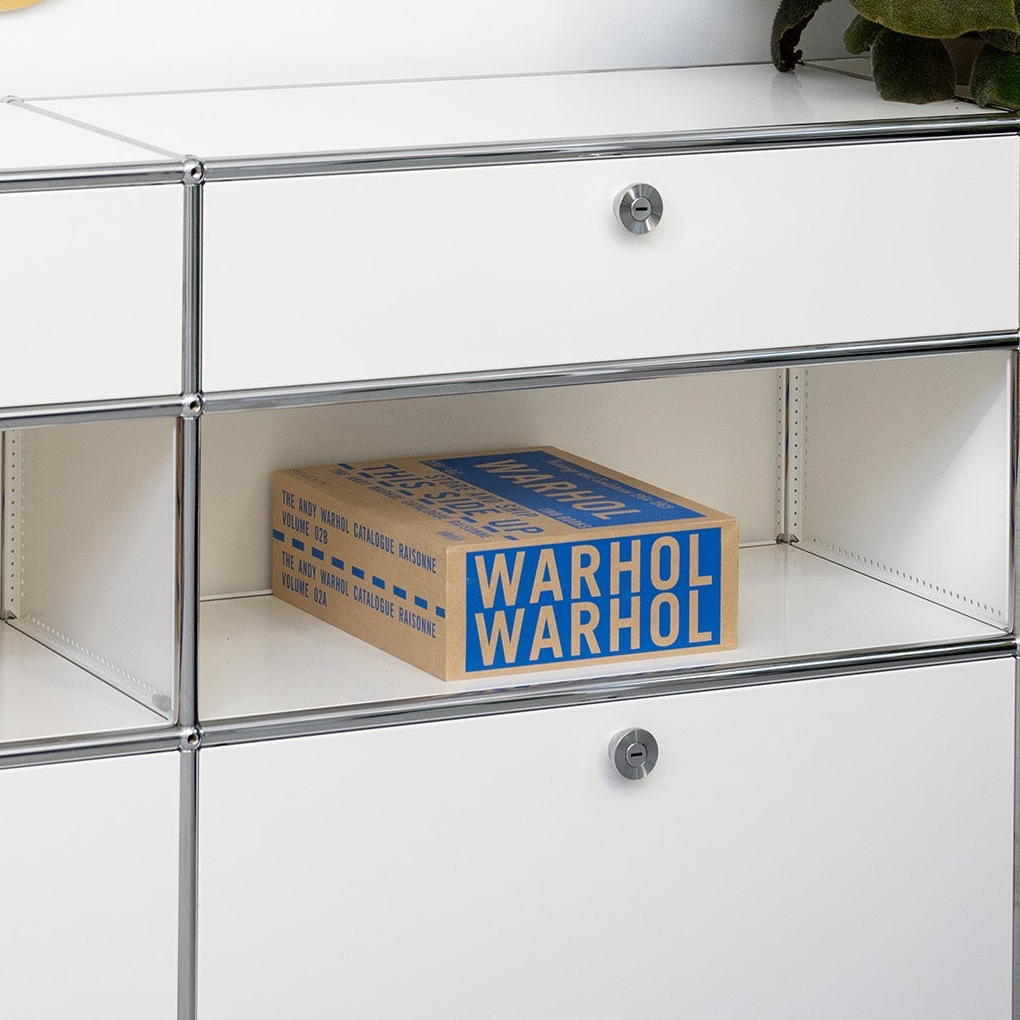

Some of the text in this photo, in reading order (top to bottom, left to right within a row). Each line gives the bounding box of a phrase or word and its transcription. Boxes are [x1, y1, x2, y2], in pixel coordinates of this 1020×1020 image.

[362, 464, 436, 489] THIS
[424, 490, 499, 517] SIDE
[487, 517, 544, 535] UP
[474, 459, 642, 520] WARHOL
[282, 510, 328, 545] VOLUME 02B
[282, 490, 437, 574] THE ANDY WARHOL CATALOGUE RAISONNE
[282, 572, 327, 607] VOLUME 02A
[282, 551, 437, 639] THE ANDY WARHOL CATALOGUE RAISONNE
[475, 535, 712, 609] WARHOL
[475, 590, 712, 667] WARHOL
